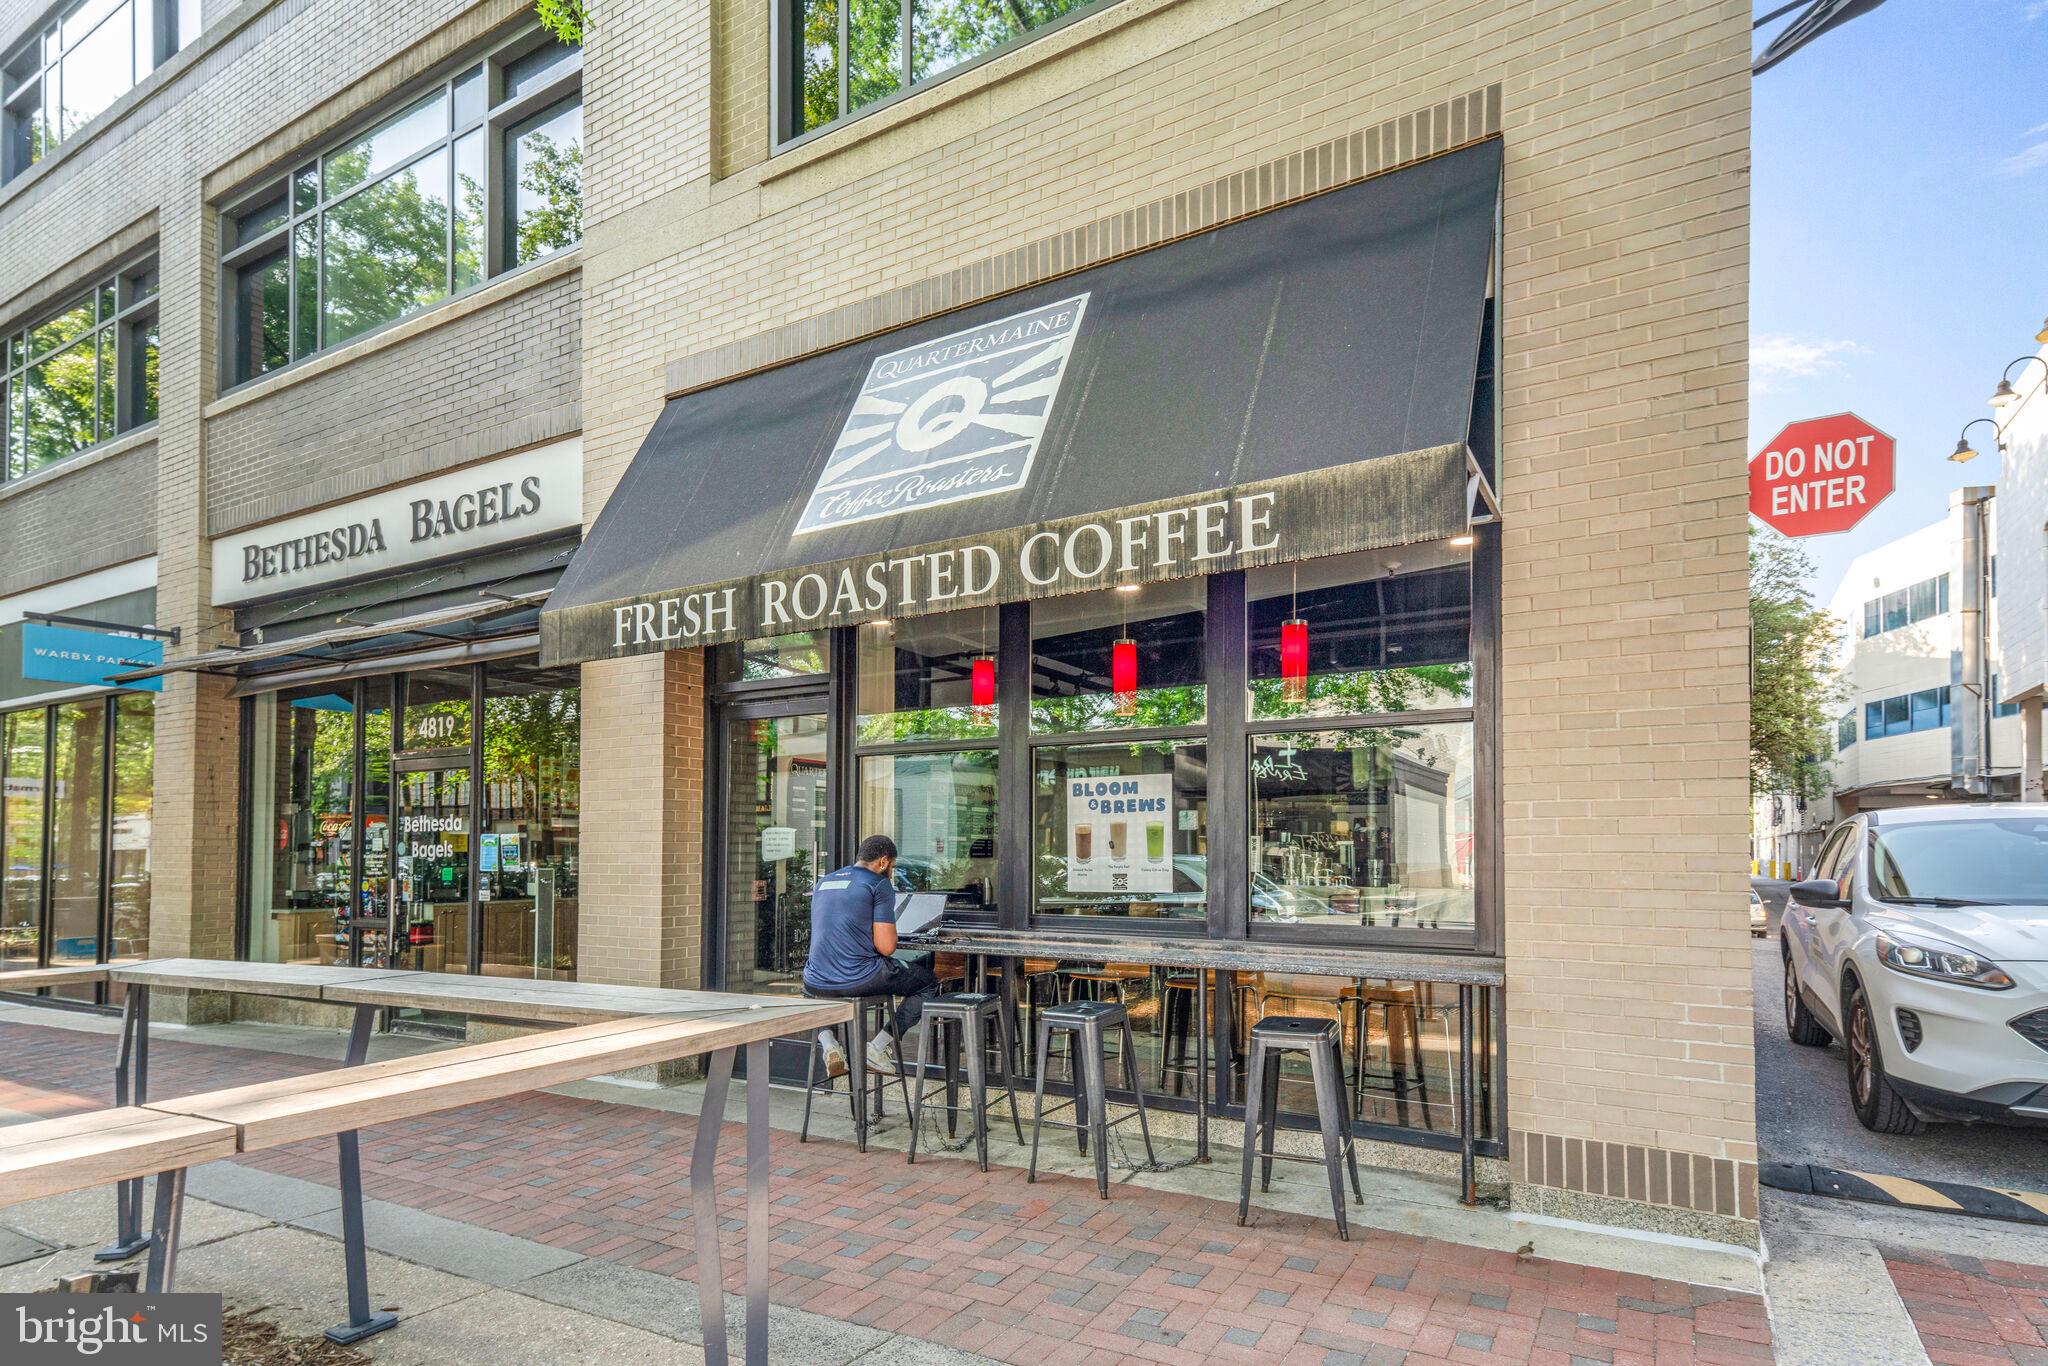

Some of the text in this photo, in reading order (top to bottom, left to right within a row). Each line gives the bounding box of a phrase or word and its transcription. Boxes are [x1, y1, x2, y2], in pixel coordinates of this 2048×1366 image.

[875, 311, 1071, 380] QUARTERMAINE
[1765, 435, 1875, 481] DO NOT
[820, 464, 1014, 519] Coffee Roasters
[1772, 475, 1866, 516] ENTER
[242, 476, 541, 583] BETHESDA BAGELS
[612, 491, 1281, 647] FRESH ROASTED COFFEE
[33, 647, 92, 662] WARBY
[419, 715, 454, 739] 4819
[1072, 781, 1139, 797] BLOOM
[1100, 797, 1166, 814] BREWS
[403, 813, 462, 834] Bethesda
[412, 840, 453, 861] Bagels
